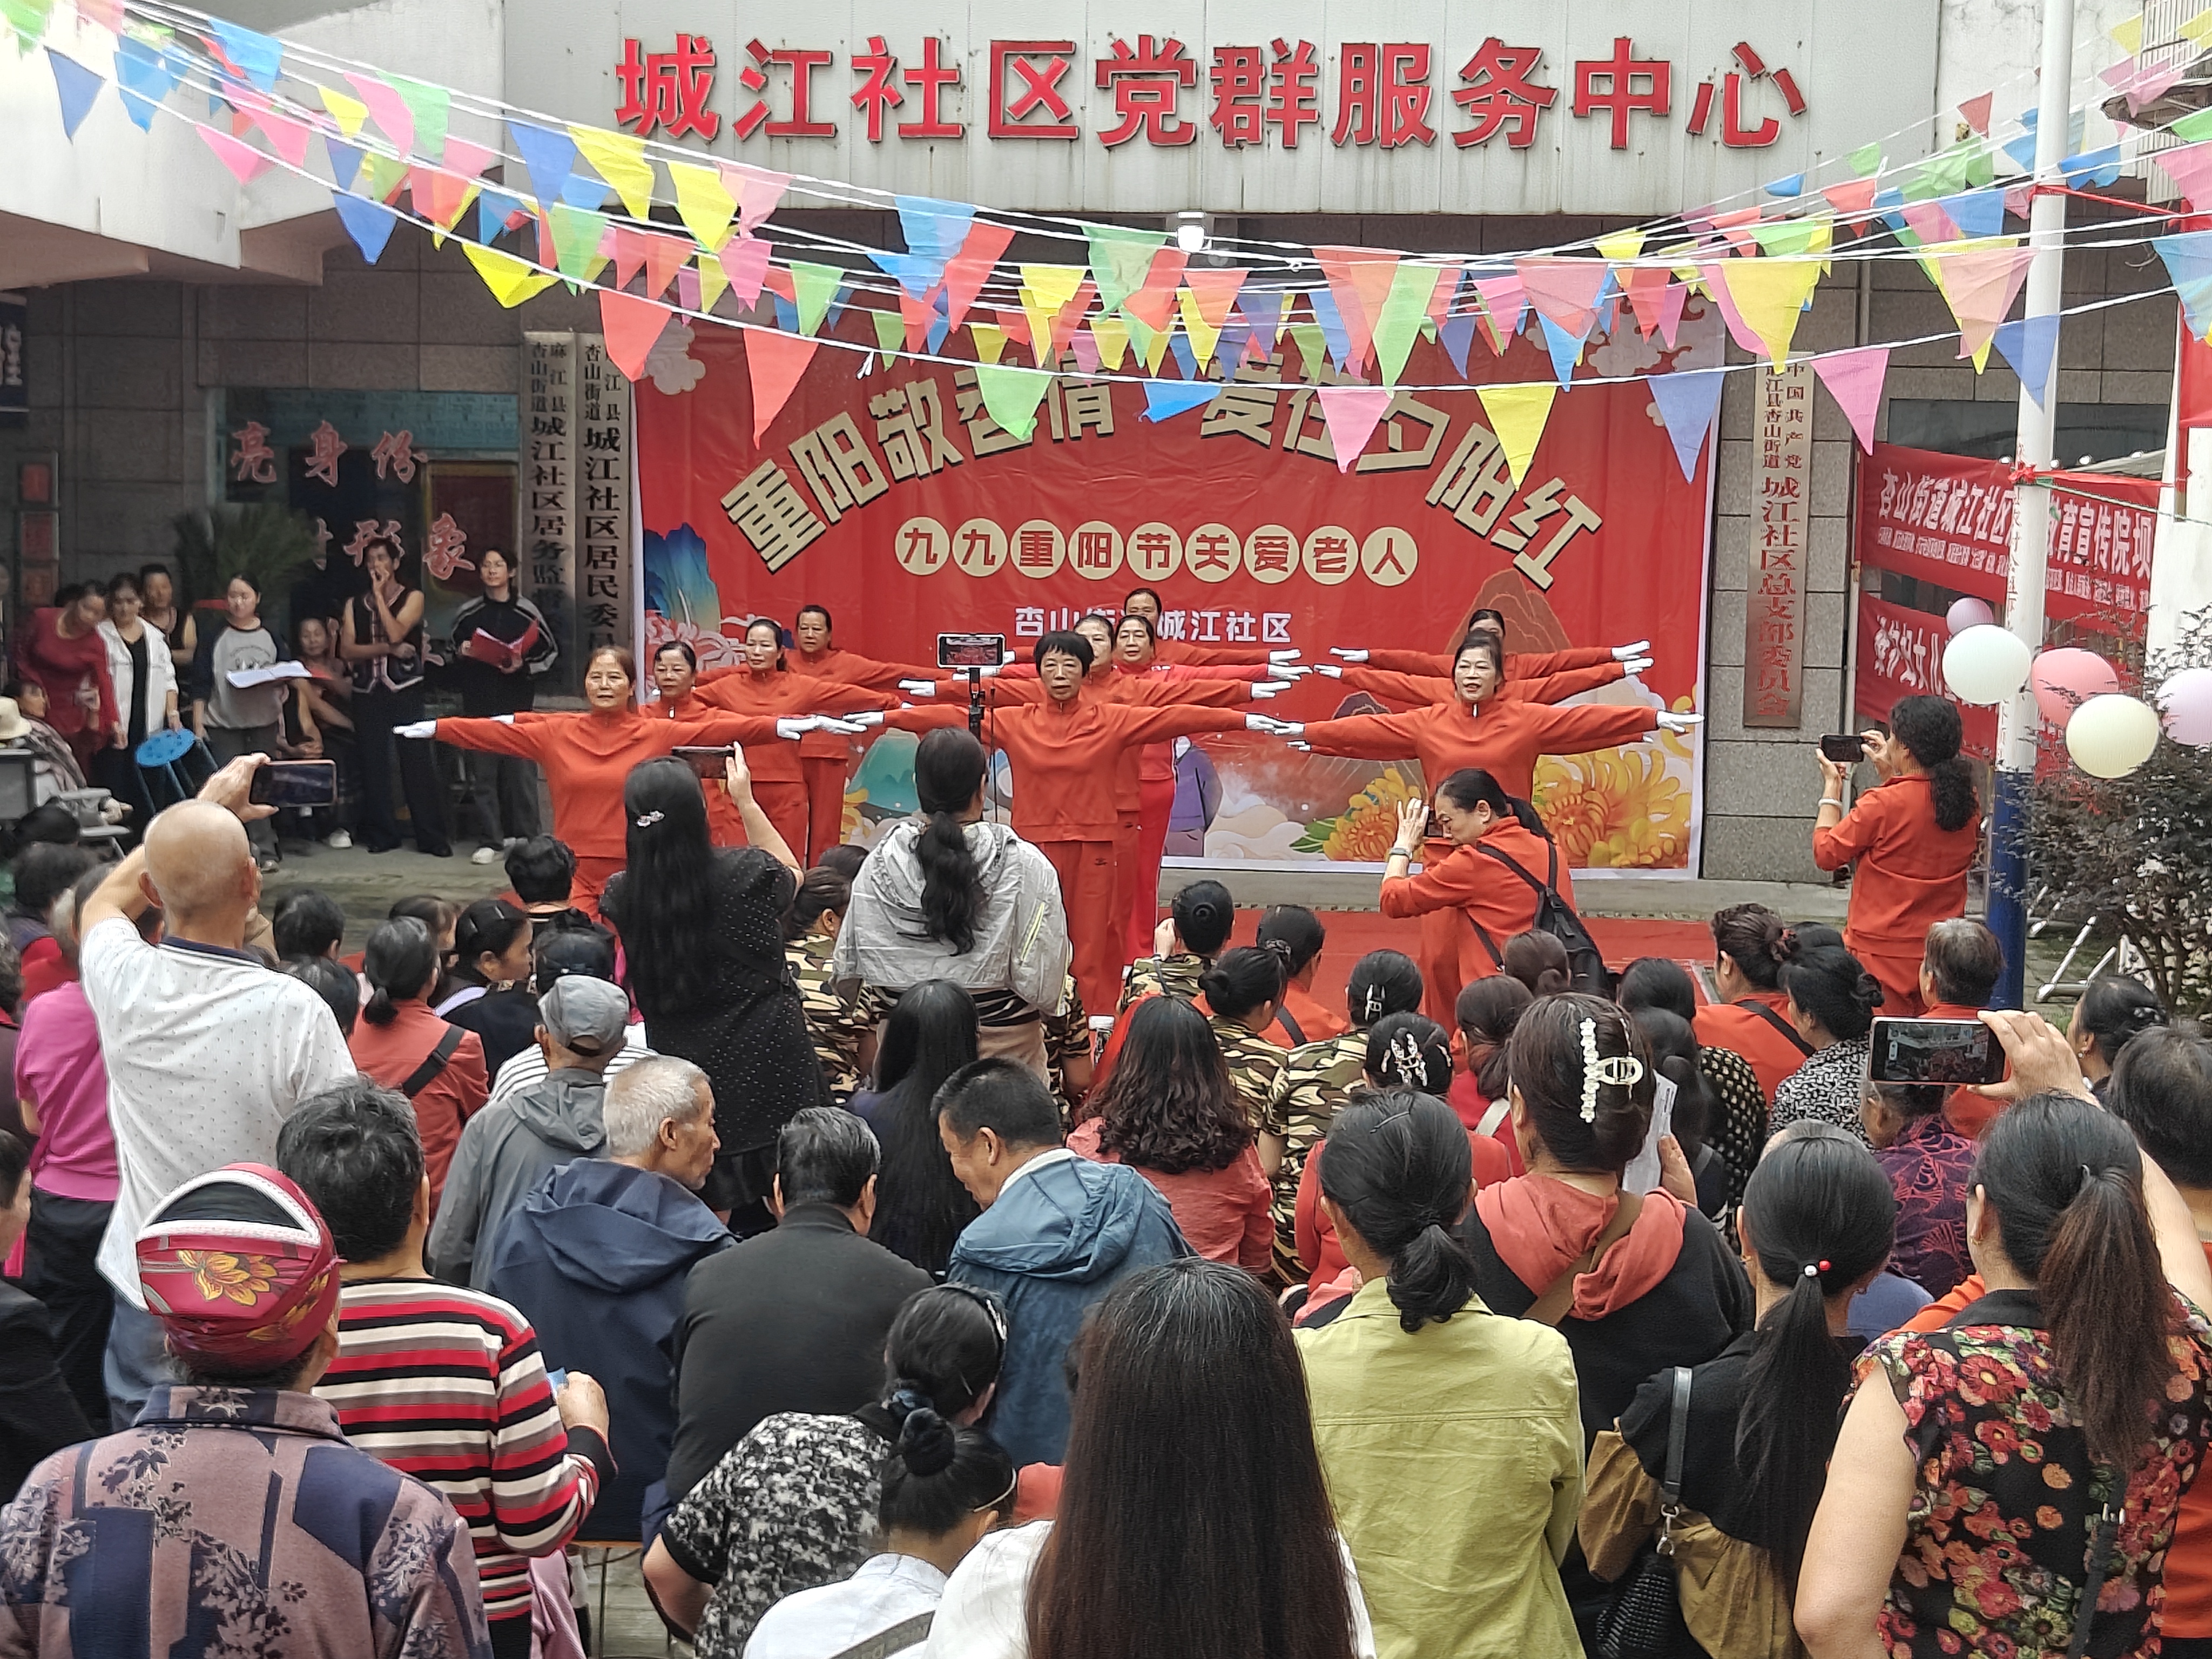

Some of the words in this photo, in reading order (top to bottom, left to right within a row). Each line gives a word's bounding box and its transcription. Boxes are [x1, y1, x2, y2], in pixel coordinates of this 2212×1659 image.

[615, 33, 1809, 150] 城江社区党群服务中心
[584, 343, 602, 421] 杏山街道
[1784, 362, 1805, 469] 中国共产党
[231, 420, 429, 488] 亮身份
[529, 416, 568, 608] 城江社区居务监
[902, 527, 1407, 575] 九九重阳节关爱老人
[1015, 606, 1293, 643] 杏山城江社区
[1756, 476, 1801, 716] 城江社区总支部委员会
